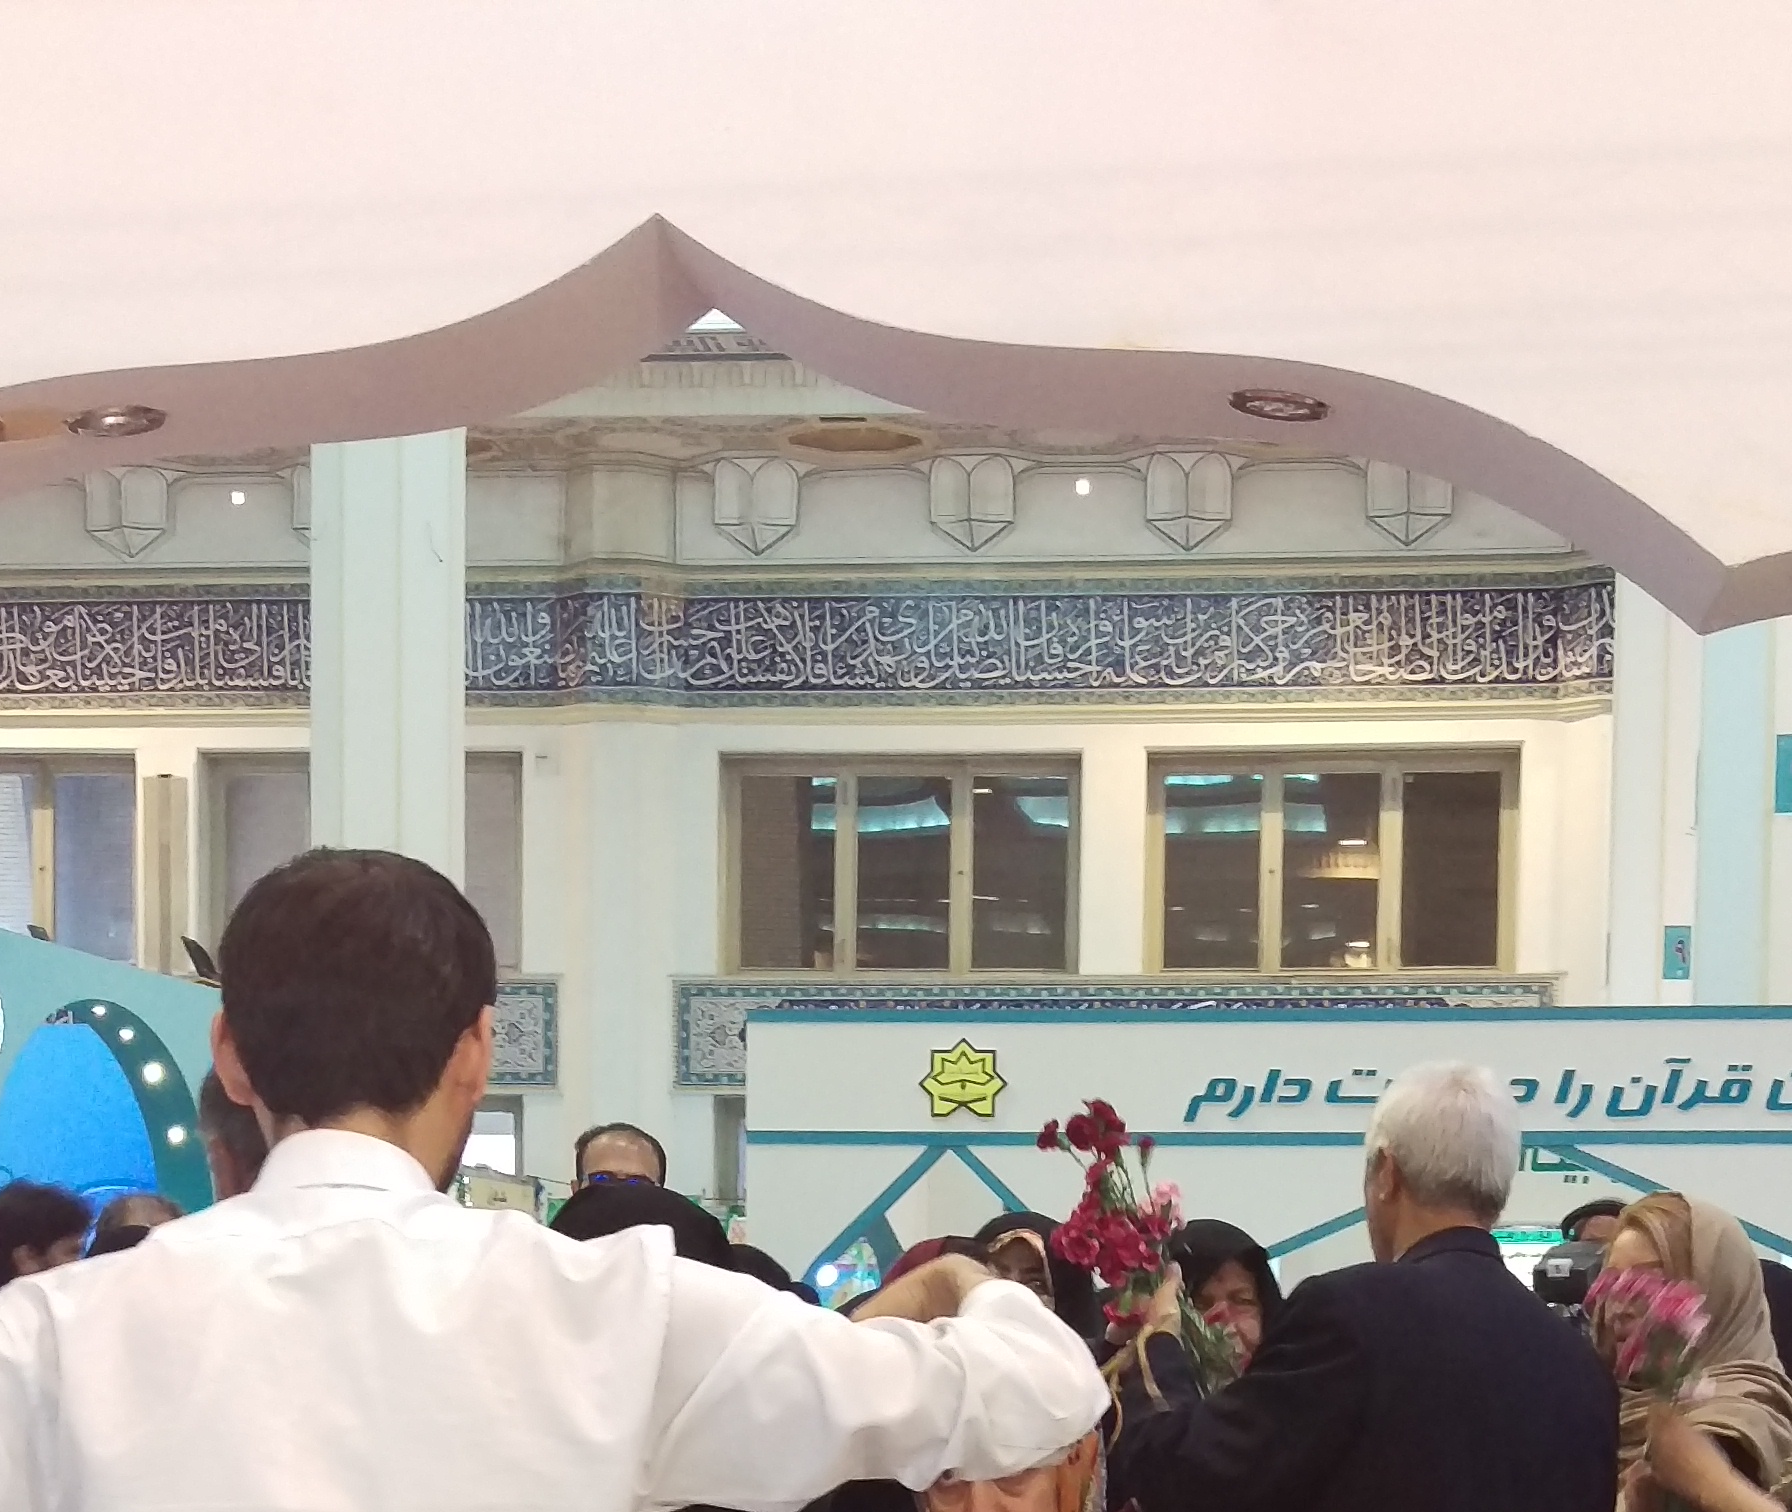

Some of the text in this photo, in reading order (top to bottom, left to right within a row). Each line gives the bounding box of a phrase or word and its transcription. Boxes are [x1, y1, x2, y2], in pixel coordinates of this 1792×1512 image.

[1183, 1068, 1312, 1122] دارم
[1554, 1068, 1594, 1119] را
[1605, 1057, 1754, 1119] قرآن
